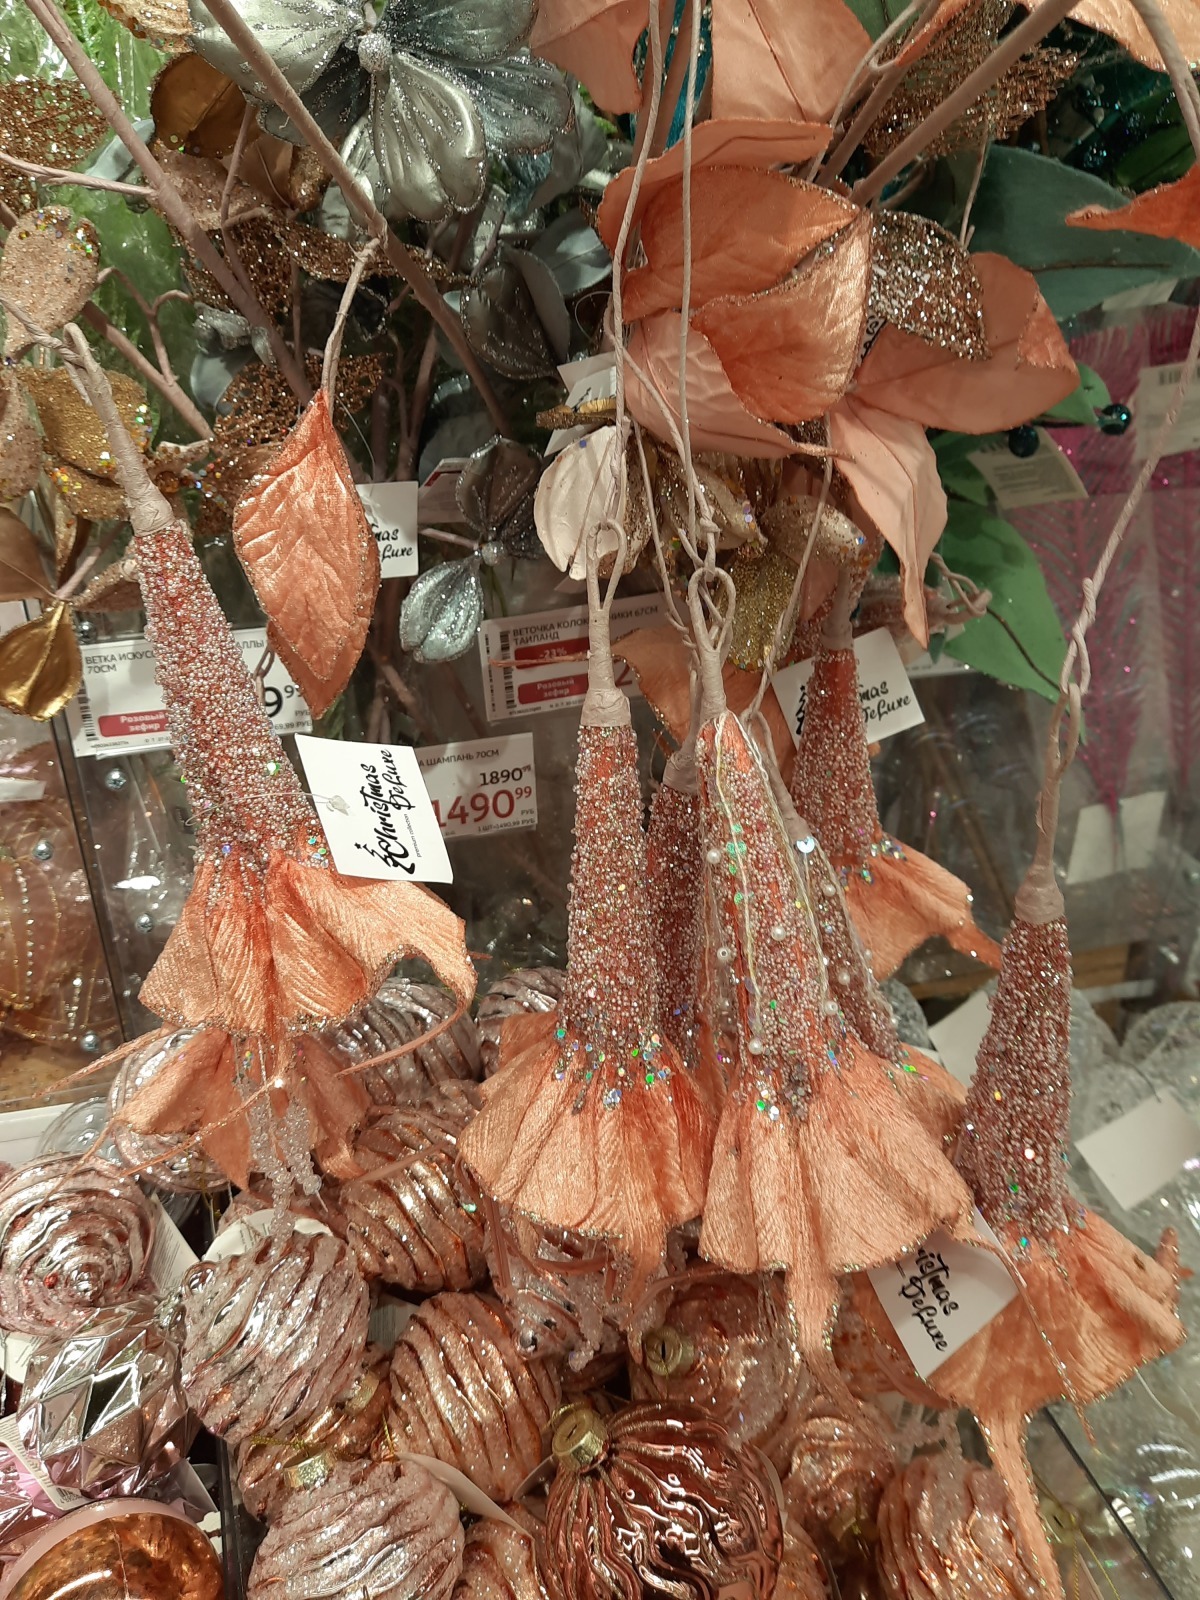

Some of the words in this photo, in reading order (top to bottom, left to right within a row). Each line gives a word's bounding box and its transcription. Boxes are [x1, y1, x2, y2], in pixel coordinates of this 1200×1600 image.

[512, 623, 556, 637] ВЕТОЧКА
[84, 654, 118, 665] ВЕТКА
[87, 664, 118, 674] 70СМ
[120, 711, 167, 723] Розовый
[129, 722, 161, 732] зефир
[426, 753, 474, 766] ШАМПАНЬ
[476, 748, 500, 759] 70СМ
[480, 767, 523, 786] 1890
[431, 789, 515, 828] 1490
[515, 785, 532, 800] 99
